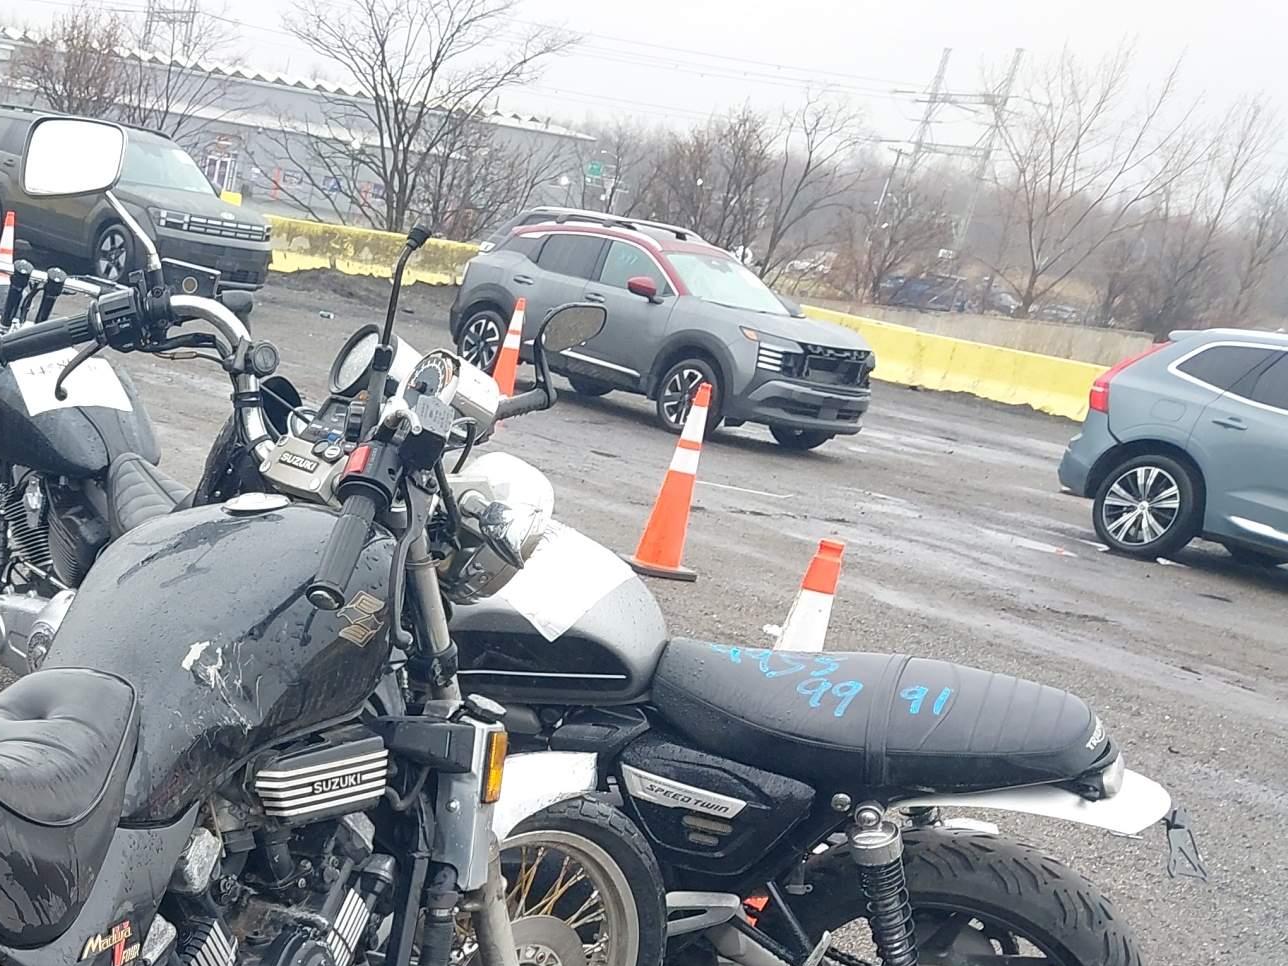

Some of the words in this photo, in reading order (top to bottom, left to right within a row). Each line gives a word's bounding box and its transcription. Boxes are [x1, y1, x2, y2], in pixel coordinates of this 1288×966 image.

[280, 452, 317, 472] SUZUKI
[796, 677, 864, 717] 99
[899, 686, 951, 715] 91
[313, 773, 361, 794] SUZUKI
[646, 784, 692, 804] SPEED
[81, 926, 133, 960] Madura
